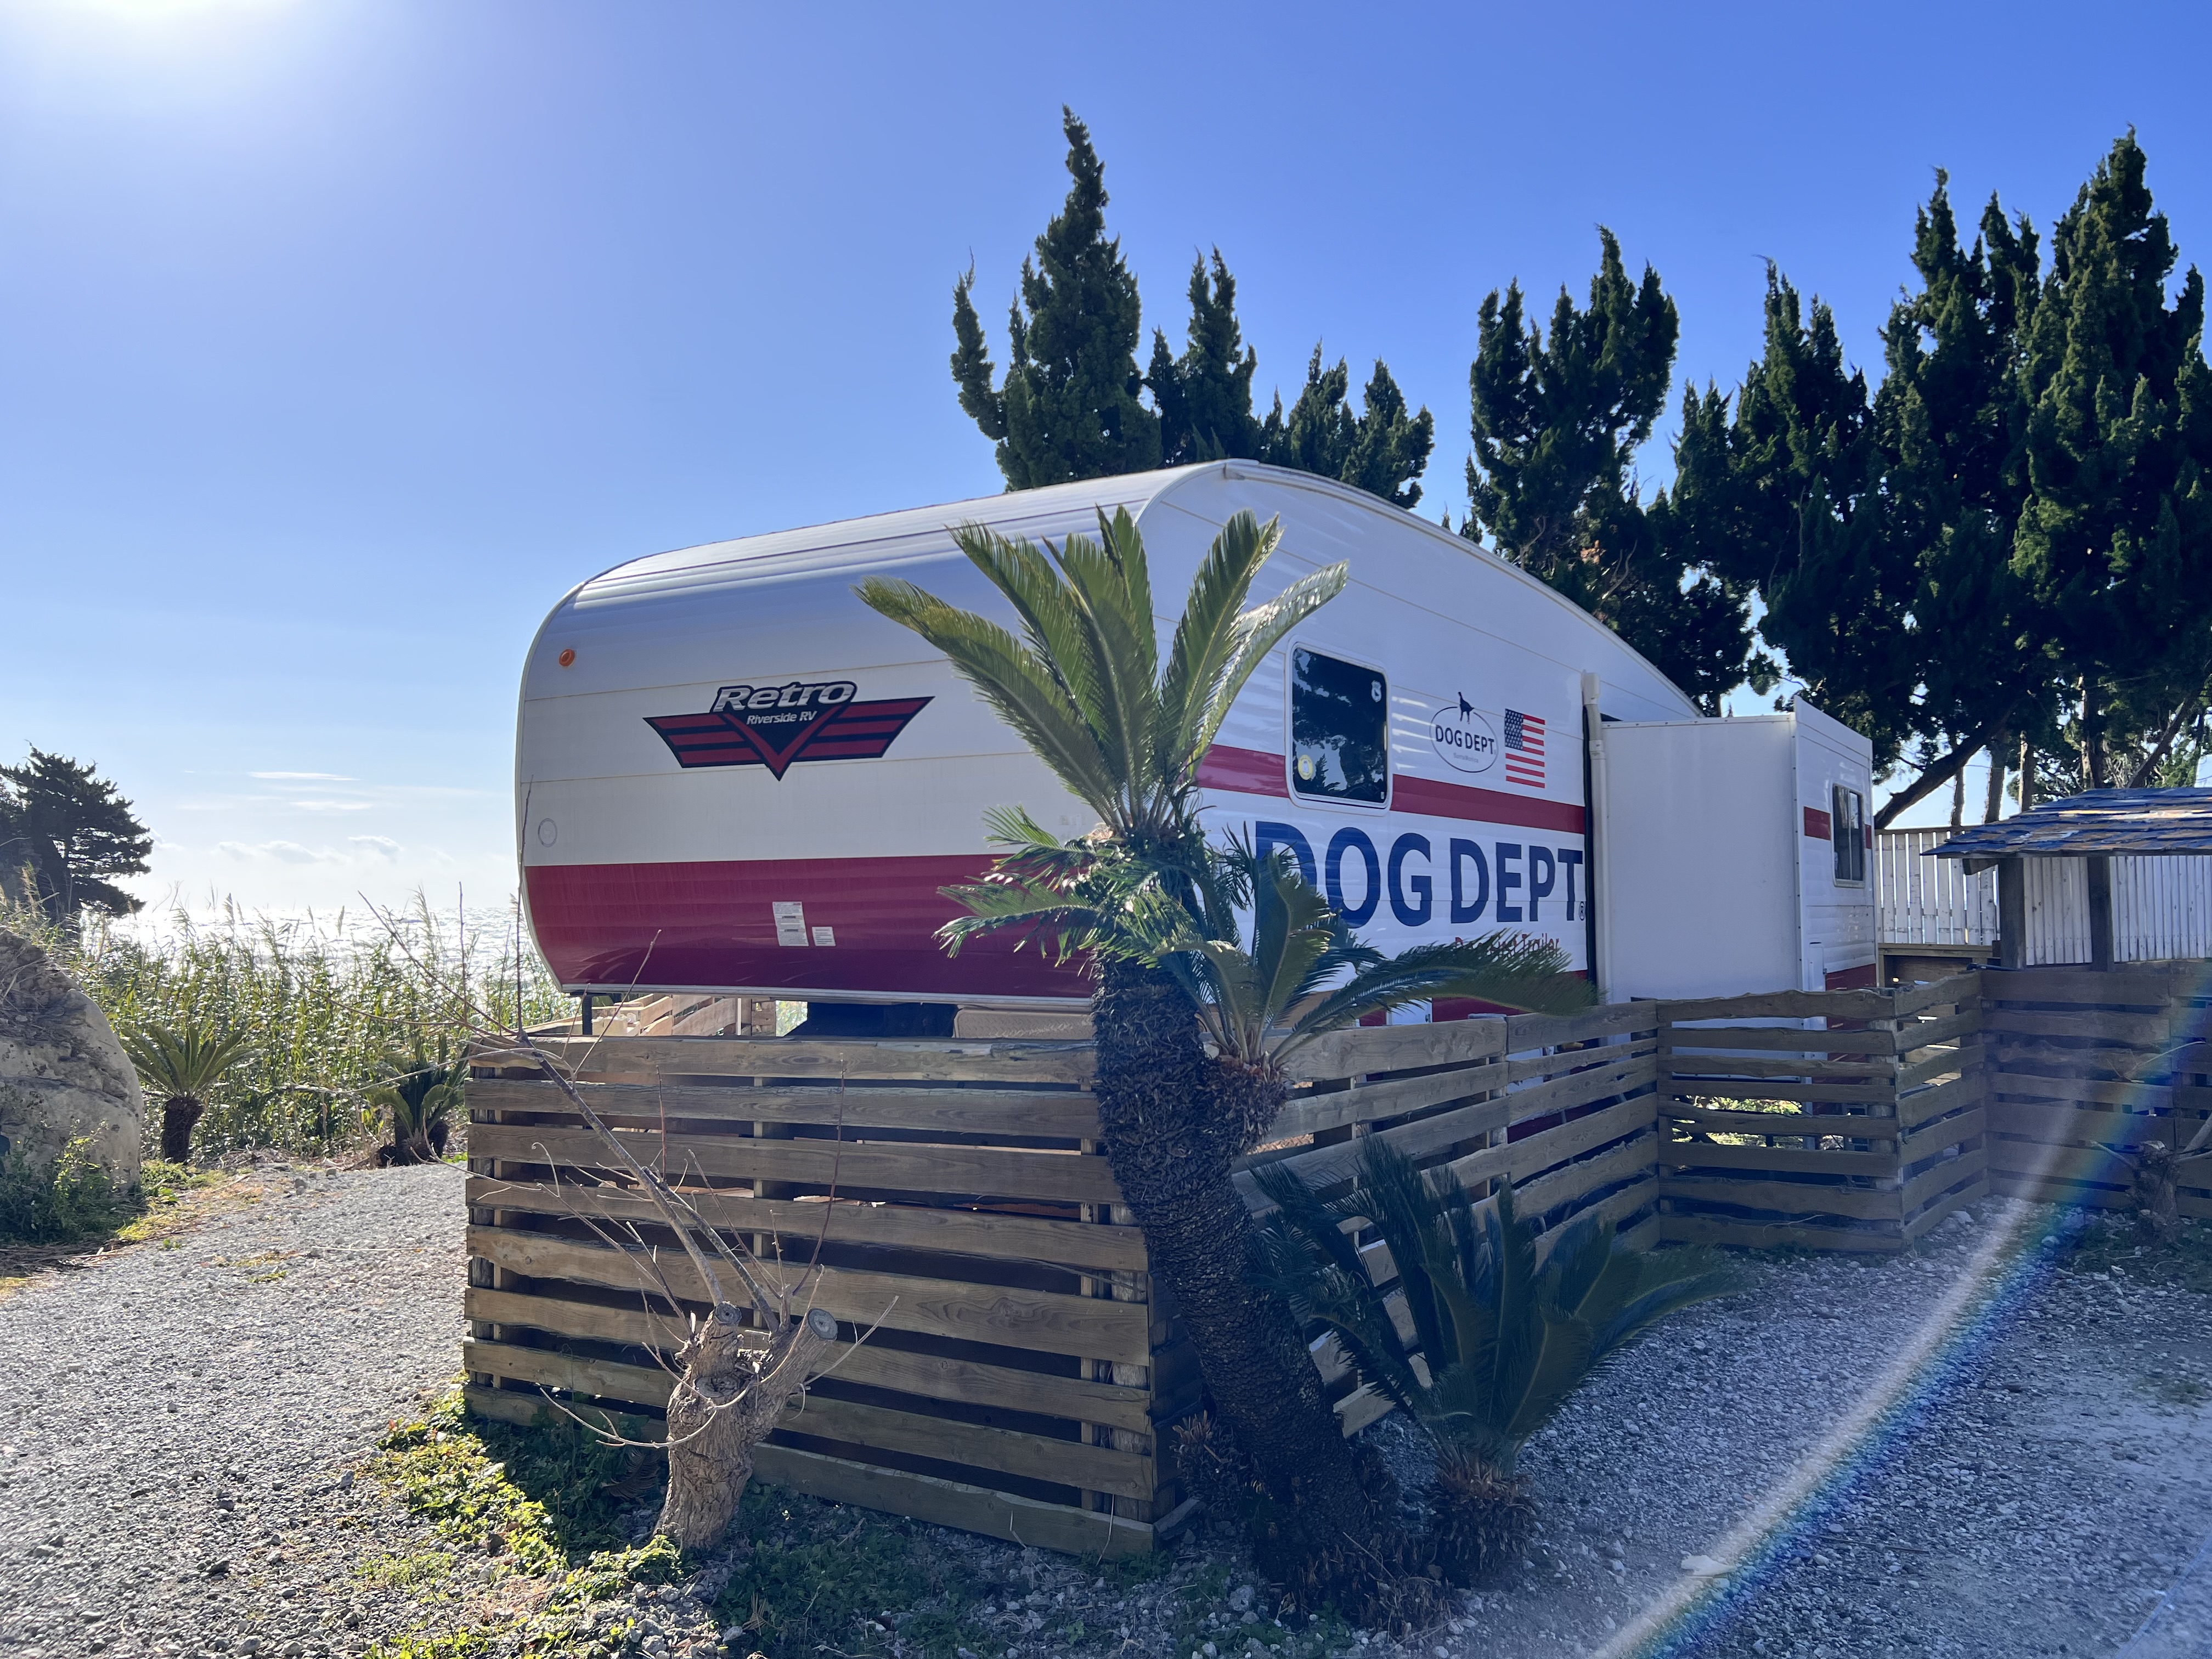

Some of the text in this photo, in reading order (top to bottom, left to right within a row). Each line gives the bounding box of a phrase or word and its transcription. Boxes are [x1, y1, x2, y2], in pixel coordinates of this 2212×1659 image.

[713, 684, 854, 712] Retro
[747, 710, 817, 725] Riverside RV
[1435, 724, 1463, 747] DOG
